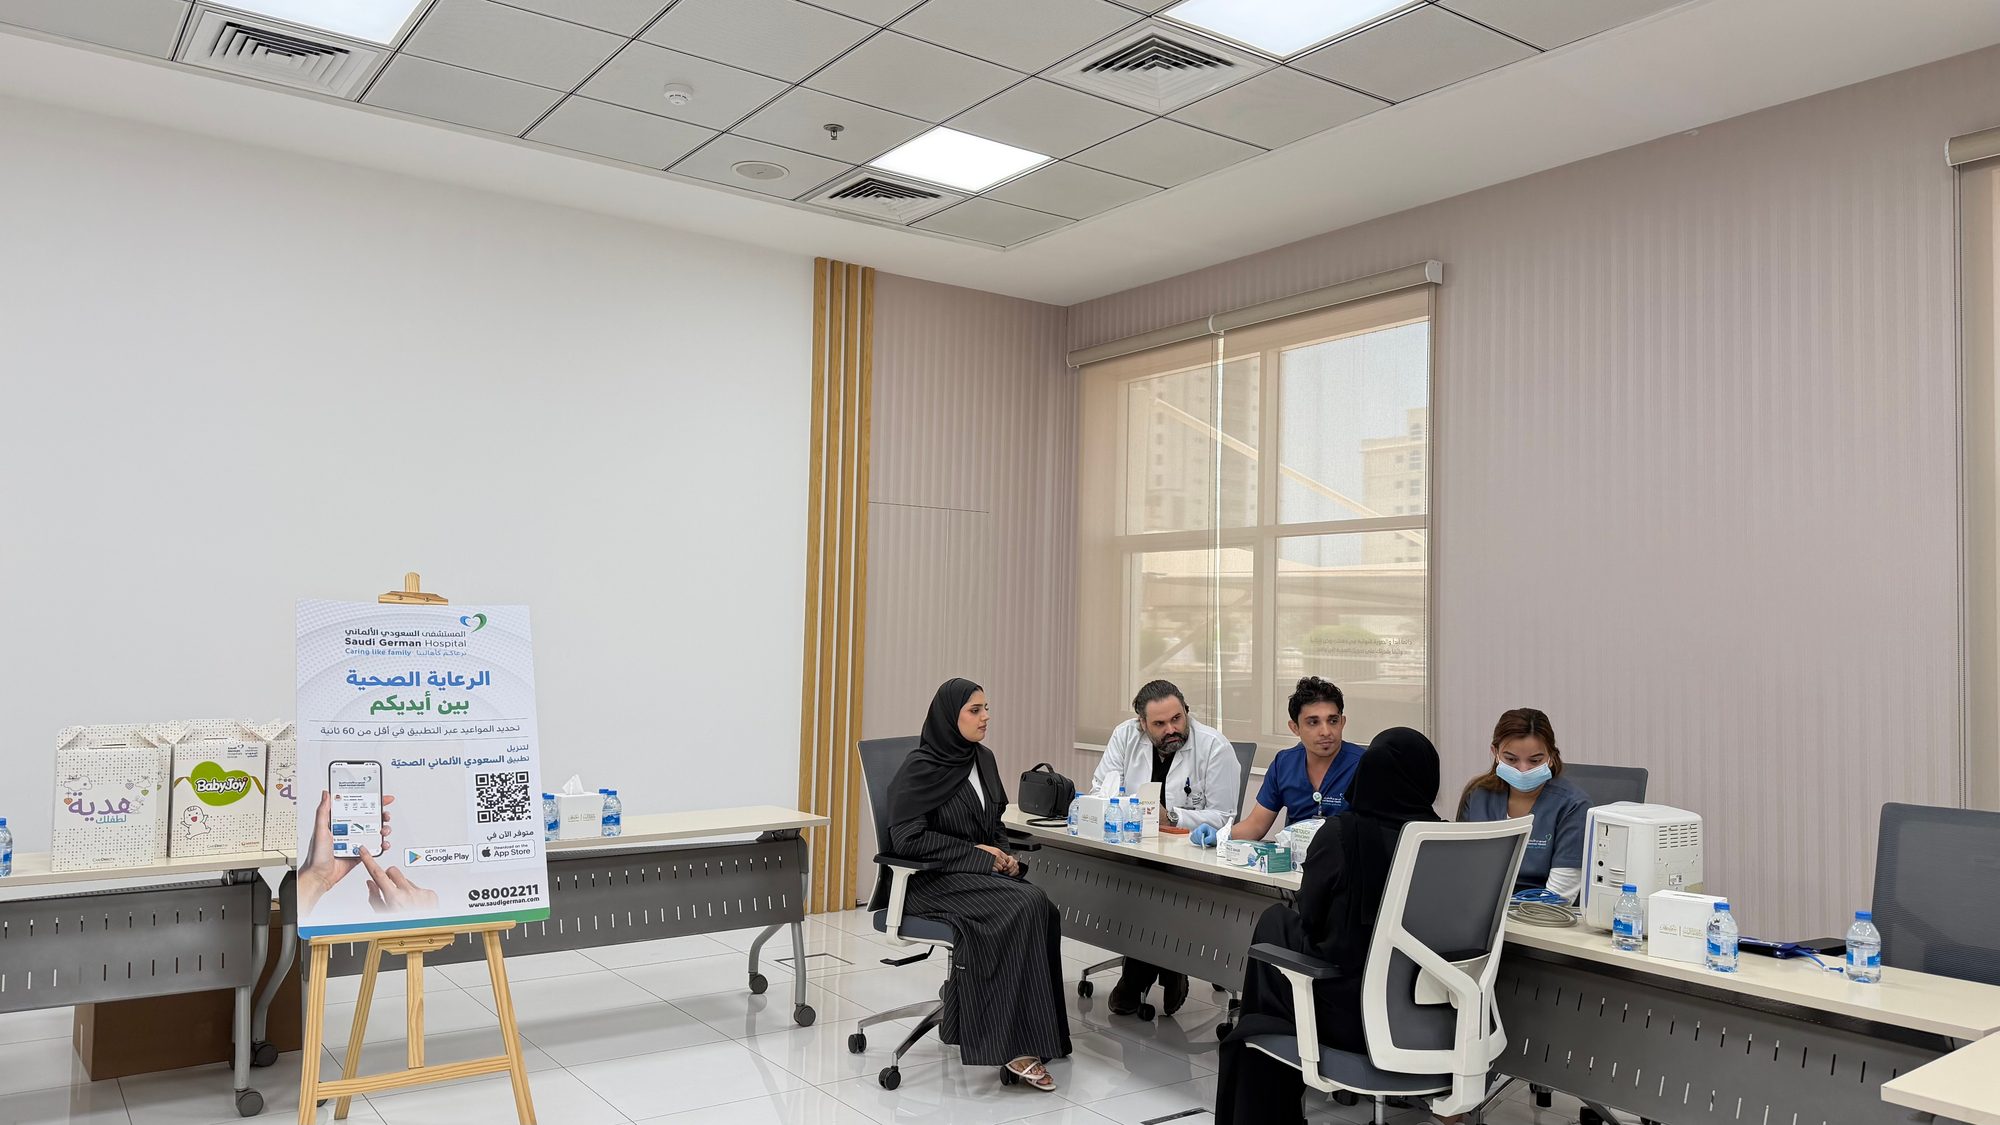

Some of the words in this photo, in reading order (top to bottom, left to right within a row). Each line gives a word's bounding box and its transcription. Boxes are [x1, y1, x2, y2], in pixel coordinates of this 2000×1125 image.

[345, 627, 379, 637] الألماني
[380, 630, 420, 639] السعودي
[345, 637, 376, 646] Saudi
[379, 638, 422, 647] German
[425, 639, 467, 648] Hospital
[345, 648, 370, 656] Caring
[372, 648, 386, 656] like
[388, 649, 412, 657] family
[346, 669, 420, 691] الصحية
[427, 670, 490, 691] الرعاية
[370, 690, 431, 715] أيديكم
[437, 699, 470, 715] بين
[320, 726, 340, 737] ثانية
[342, 727, 355, 735] 60
[357, 728, 372, 737] من
[373, 726, 390, 737] أقل
[391, 727, 405, 738] في
[407, 726, 442, 737] التطبيق
[443, 726, 458, 736] عبر
[460, 725, 495, 735] المواعيد
[496, 725, 520, 733] تحديد
[506, 744, 529, 753] لتنزيل
[428, 756, 461, 770] الألماني
[463, 755, 505, 769] السعودي
[506, 755, 530, 764] تطبيق
[196, 777, 248, 793] BabyJoy
[68, 792, 131, 821] هدية
[96, 815, 127, 824] لطفلك
[486, 832, 497, 841] في
[498, 830, 512, 840] الآن
[513, 830, 535, 839] متوفر
[425, 853, 453, 863] Google
[453, 853, 470, 861] Play
[494, 850, 510, 858] App
[510, 848, 531, 856] Store
[481, 884, 539, 900] 8002211
[468, 897, 540, 908] www.saudigerman.com
